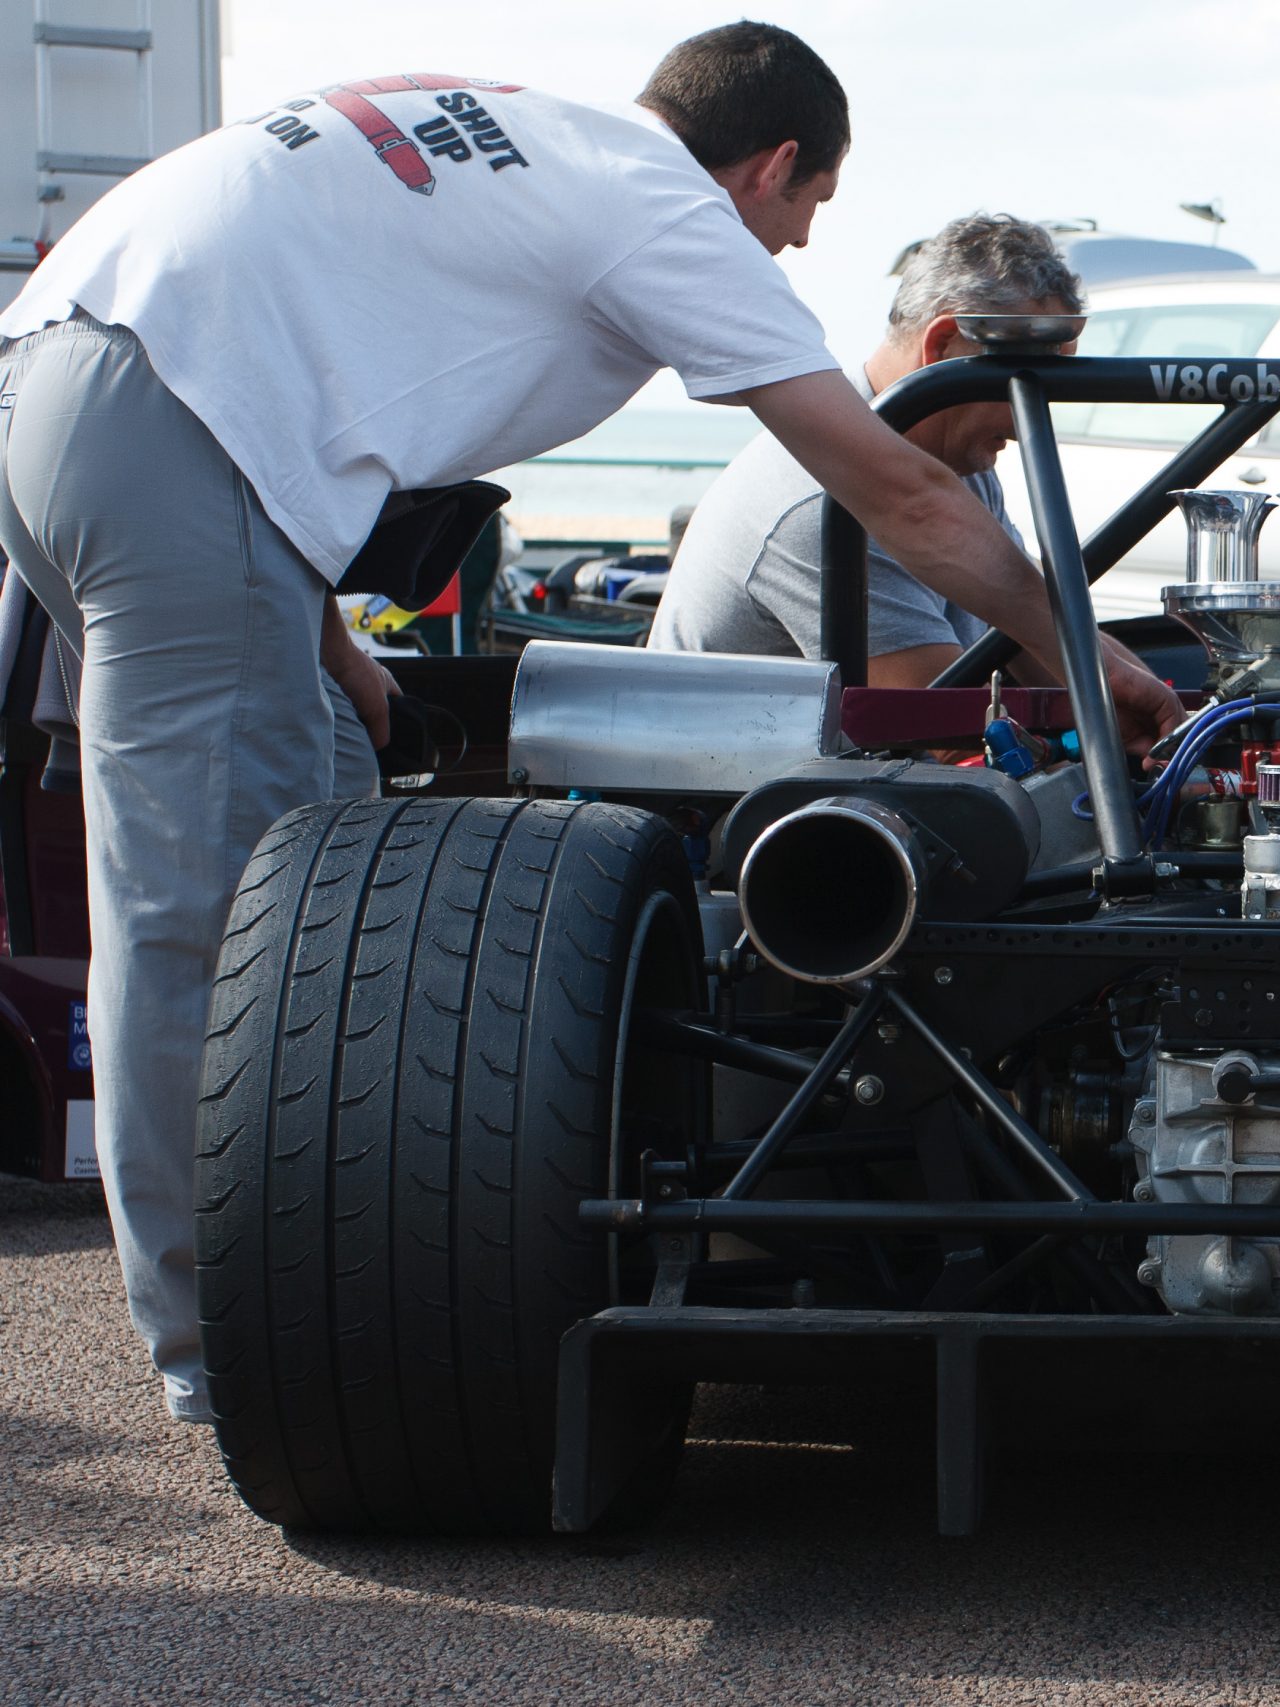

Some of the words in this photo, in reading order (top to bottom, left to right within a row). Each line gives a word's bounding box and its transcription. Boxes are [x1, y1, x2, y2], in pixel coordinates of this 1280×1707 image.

[264, 115, 321, 151] ON
[413, 115, 472, 163] UP
[435, 92, 530, 172] SHUT
